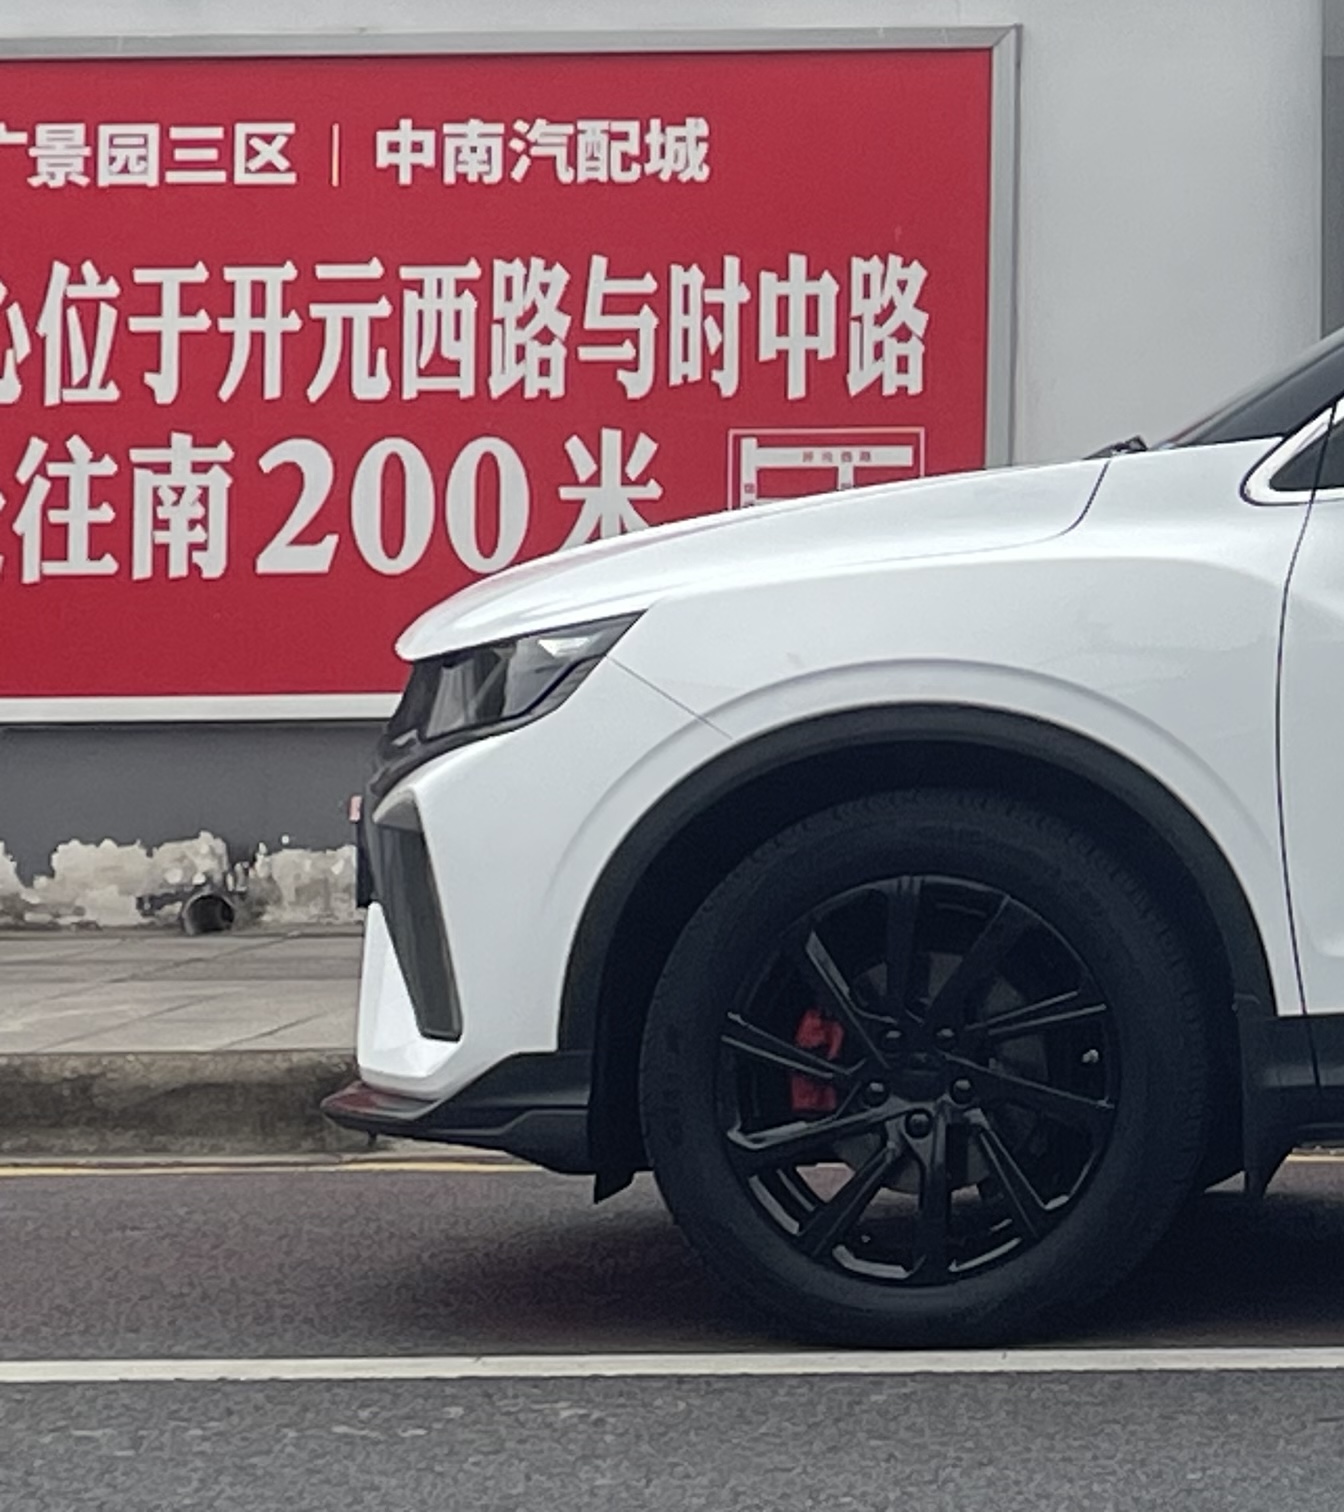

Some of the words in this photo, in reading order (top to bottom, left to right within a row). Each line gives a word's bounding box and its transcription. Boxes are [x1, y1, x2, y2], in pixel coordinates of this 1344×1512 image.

[376, 117, 710, 186] 中南汽配城
[0, 427, 663, 584] 往南200米
